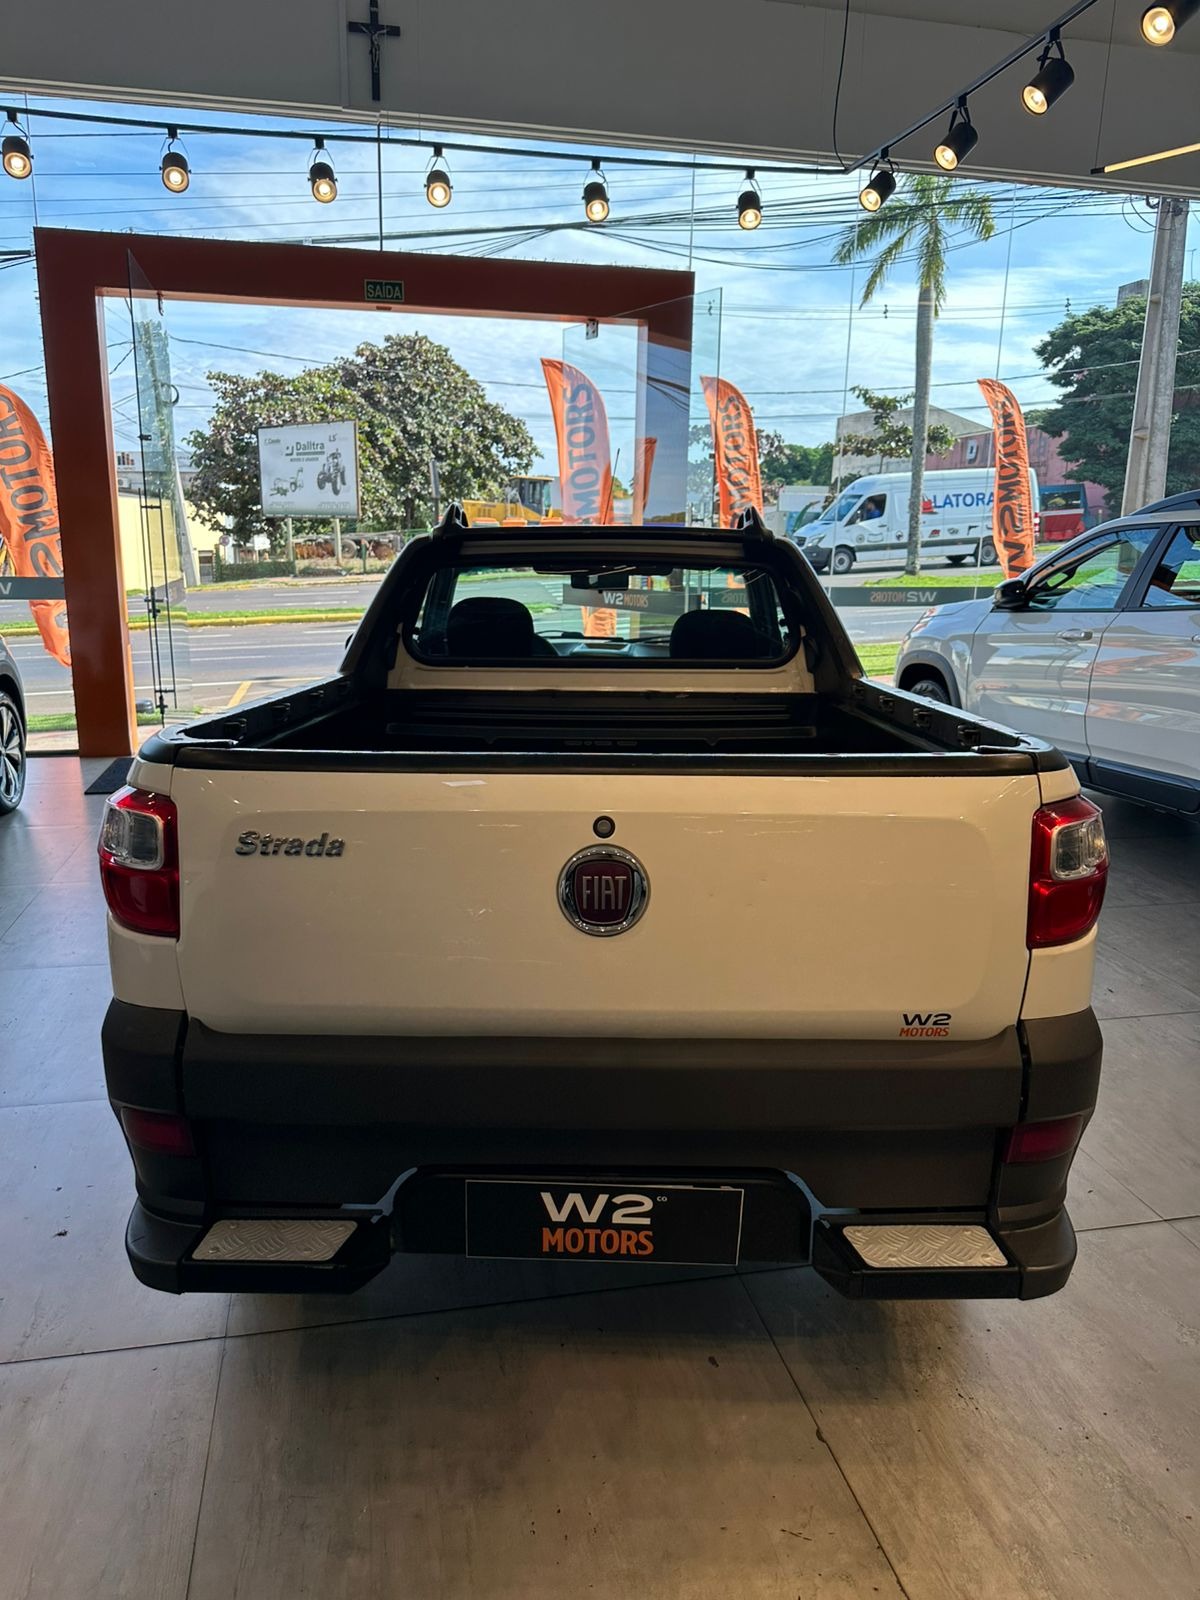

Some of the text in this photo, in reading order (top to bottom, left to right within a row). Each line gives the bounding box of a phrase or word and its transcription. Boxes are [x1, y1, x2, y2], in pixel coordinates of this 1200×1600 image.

[367, 282, 402, 298] SAÍDA
[296, 441, 325, 452] Dalltra
[563, 382, 600, 518] MOTORS
[718, 395, 752, 513] MOTORS
[235, 831, 346, 857] Strada
[582, 876, 627, 910] FIAT
[899, 1027, 949, 1037] MOTORS
[902, 1012, 952, 1026] W2
[540, 1191, 654, 1225] W2
[542, 1227, 654, 1255] MOTORS
